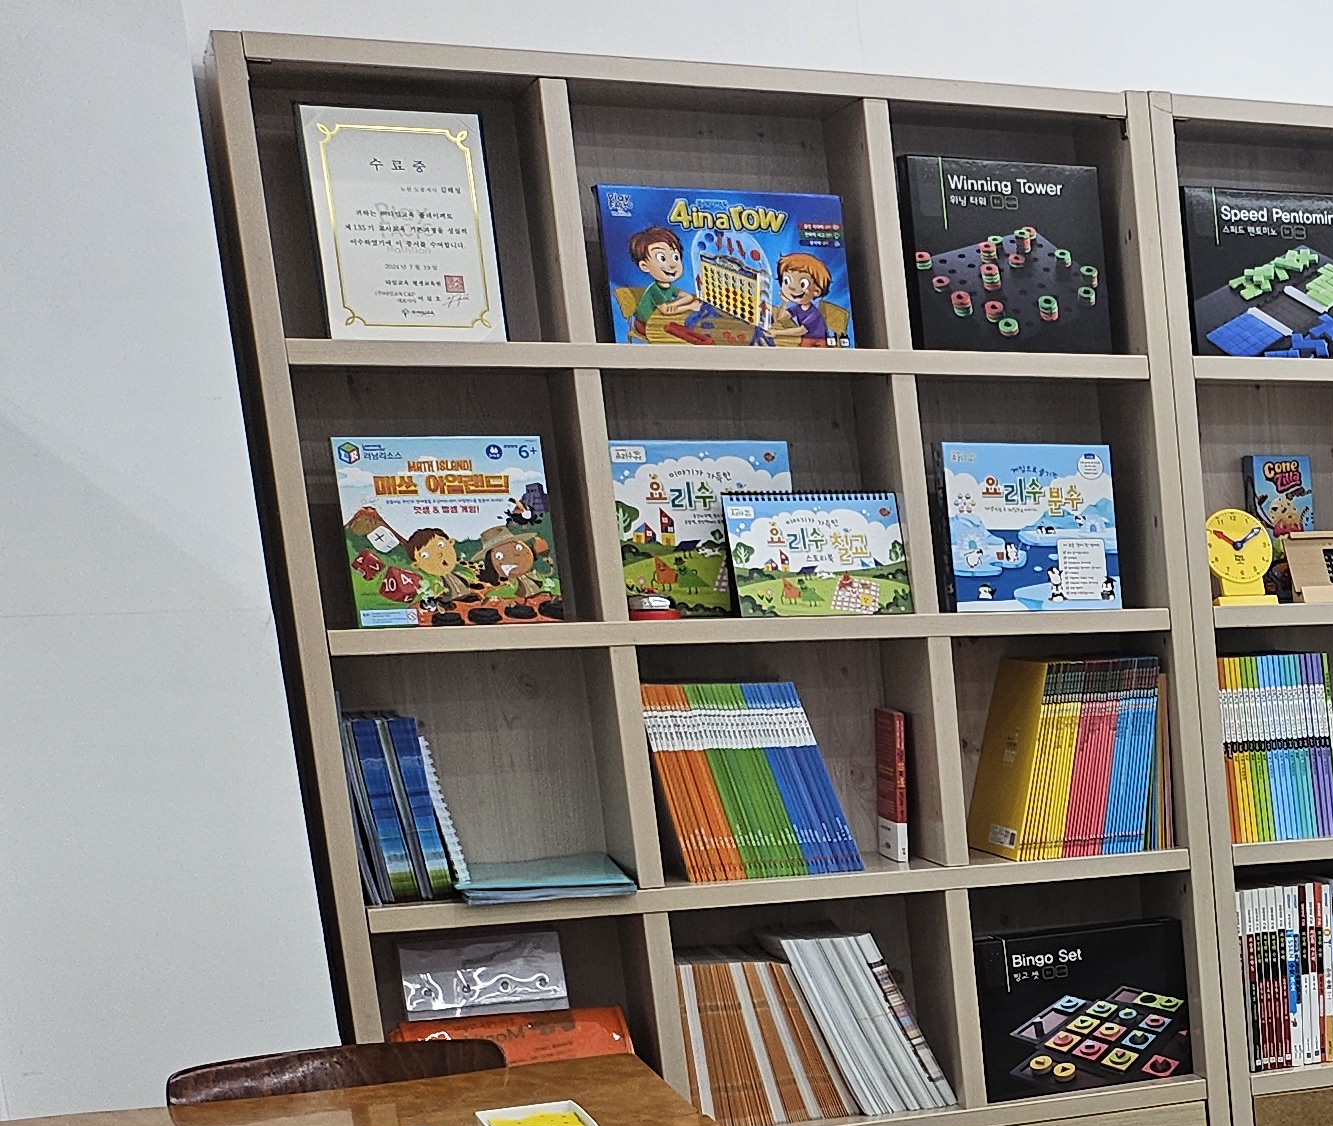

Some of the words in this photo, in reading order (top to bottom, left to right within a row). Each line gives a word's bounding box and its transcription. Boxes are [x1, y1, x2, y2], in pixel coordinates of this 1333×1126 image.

[947, 174, 1012, 195] Winning
[1016, 178, 1064, 196] Tower
[1220, 205, 1268, 223] Speed
[407, 459, 435, 473] MATH
[1263, 459, 1300, 481] Cone
[1273, 472, 1302, 492] Zilla
[645, 481, 716, 510] 요리수
[981, 475, 1045, 504] 요리수
[1048, 485, 1084, 517] 분수
[767, 526, 826, 551] 요리수
[829, 532, 871, 564] 칠교
[1011, 953, 1054, 968] Bingo
[1058, 949, 1083, 963] Set
